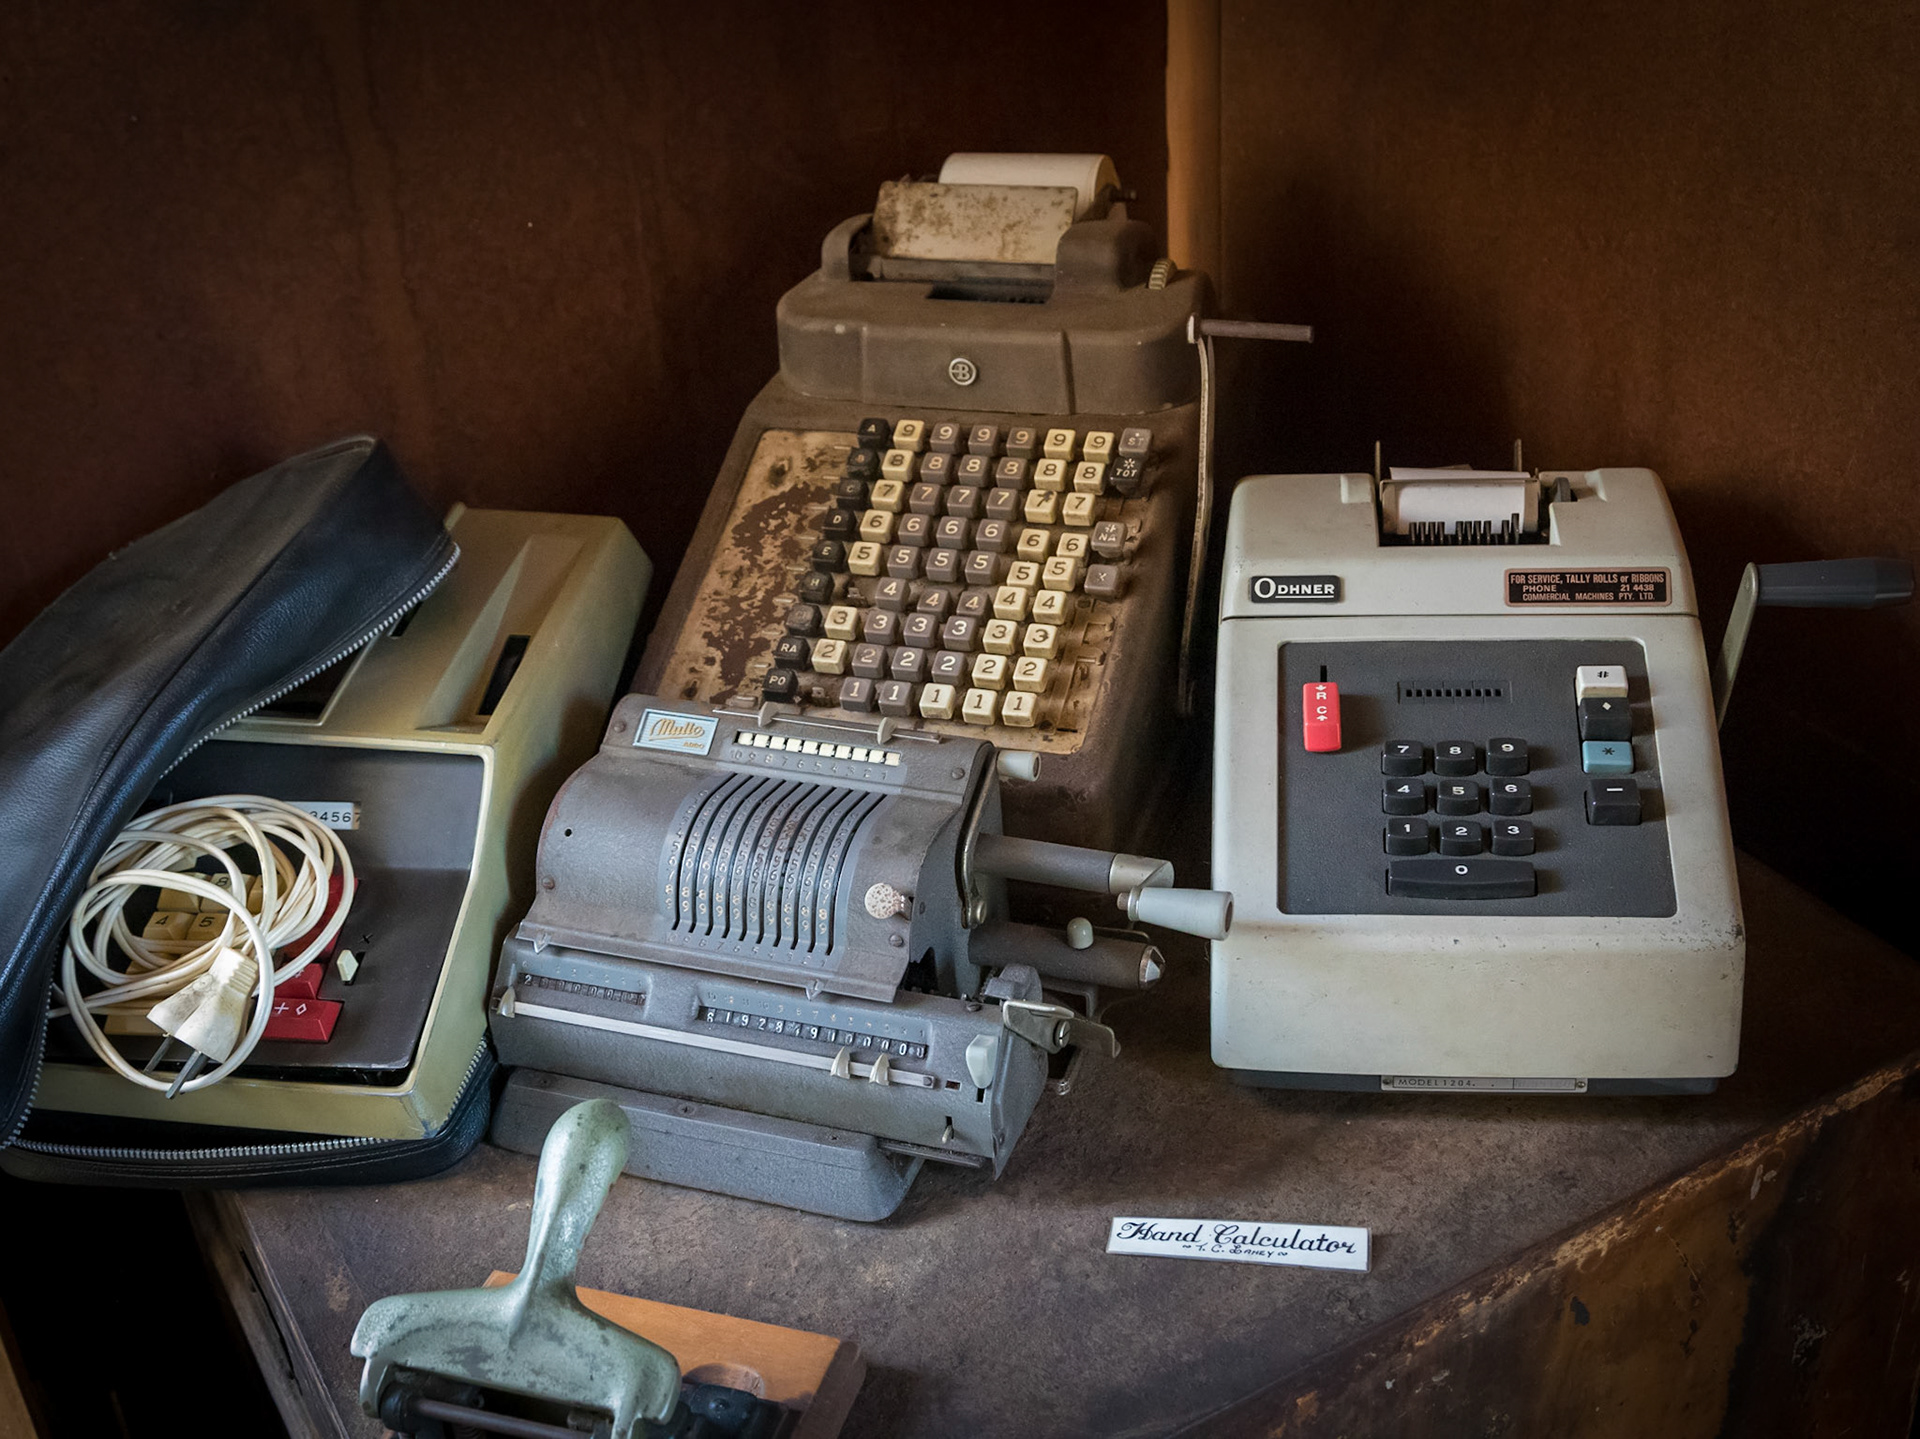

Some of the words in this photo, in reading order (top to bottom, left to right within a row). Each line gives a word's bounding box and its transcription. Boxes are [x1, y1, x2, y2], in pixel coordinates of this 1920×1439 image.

[868, 424, 876, 433] A
[902, 424, 915, 436] 9
[940, 427, 952, 438] 9
[978, 429, 990, 441] 9
[1017, 432, 1028, 443] 9
[1053, 434, 1066, 446] 9
[1092, 436, 1105, 448] 9
[890, 454, 904, 466] 8
[929, 457, 942, 468] 8
[967, 460, 980, 471] 8
[1006, 462, 1018, 474] 8
[1043, 464, 1056, 476] 8
[1083, 467, 1096, 478] 8
[1116, 468, 1137, 477] TOT
[883, 484, 894, 496] 7
[922, 487, 932, 498] 7
[960, 490, 970, 502] 7
[998, 492, 1009, 504] 7
[1037, 494, 1050, 507] 7
[1075, 497, 1085, 509] 7
[833, 515, 841, 524] D
[870, 516, 882, 527] 6
[908, 518, 920, 530] 6
[946, 521, 958, 533] 6
[986, 524, 998, 536] 6
[1026, 535, 1040, 546] 6
[1066, 538, 1078, 552] 6
[822, 547, 831, 555] E
[858, 547, 871, 559] 5
[896, 550, 910, 562] 5
[935, 553, 949, 566] 5
[974, 556, 988, 568] 5
[1016, 567, 1030, 580] 5
[1052, 562, 1065, 575] 5
[1254, 577, 1335, 598] ODHNER
[1511, 575, 1525, 584] FOR
[1528, 574, 1563, 584] SERVICE,
[1565, 574, 1590, 584] TALLY
[1593, 574, 1618, 583] ROLLS
[1620, 575, 1629, 583] or
[1631, 573, 1664, 583] RIBBONS
[1620, 584, 1630, 592] 21
[1633, 584, 1655, 592] 4438
[884, 582, 896, 595] 4
[927, 594, 938, 606] 4
[966, 595, 978, 608] 4
[1003, 592, 1015, 604] 4
[1042, 596, 1054, 608] 4
[1523, 593, 1570, 601] COMMERCIAL
[1639, 592, 1655, 600] LTD.
[834, 611, 847, 624] 3
[874, 615, 887, 628] 3
[913, 618, 927, 631] 3
[952, 621, 966, 634] 3
[992, 625, 1006, 638] 3
[1033, 629, 1048, 643] 3
[780, 644, 797, 653] RA
[822, 644, 835, 658] 2
[861, 649, 875, 662] 2
[900, 652, 914, 666] 2
[941, 656, 955, 670] 2
[982, 660, 996, 673] 2
[1023, 662, 1036, 675] 2
[850, 682, 859, 696] 1
[890, 686, 898, 700] 1
[932, 690, 940, 702] 1
[974, 694, 982, 708] 1
[1014, 697, 1022, 710] 1
[1316, 691, 1327, 700] R
[1316, 706, 1327, 714] C
[1397, 745, 1409, 753] 7
[1449, 746, 1462, 755] 8
[1501, 743, 1514, 752] 9
[1397, 785, 1410, 793] 4
[1452, 786, 1465, 795] 5
[1505, 784, 1517, 793] 6
[1404, 824, 1411, 832] 1
[1455, 826, 1468, 836] 2
[1507, 826, 1520, 834] 3
[156, 916, 169, 925] 4
[199, 916, 215, 927] 5
[1116, 1222, 1204, 1242] Hand
[1213, 1224, 1357, 1254] Calculator
